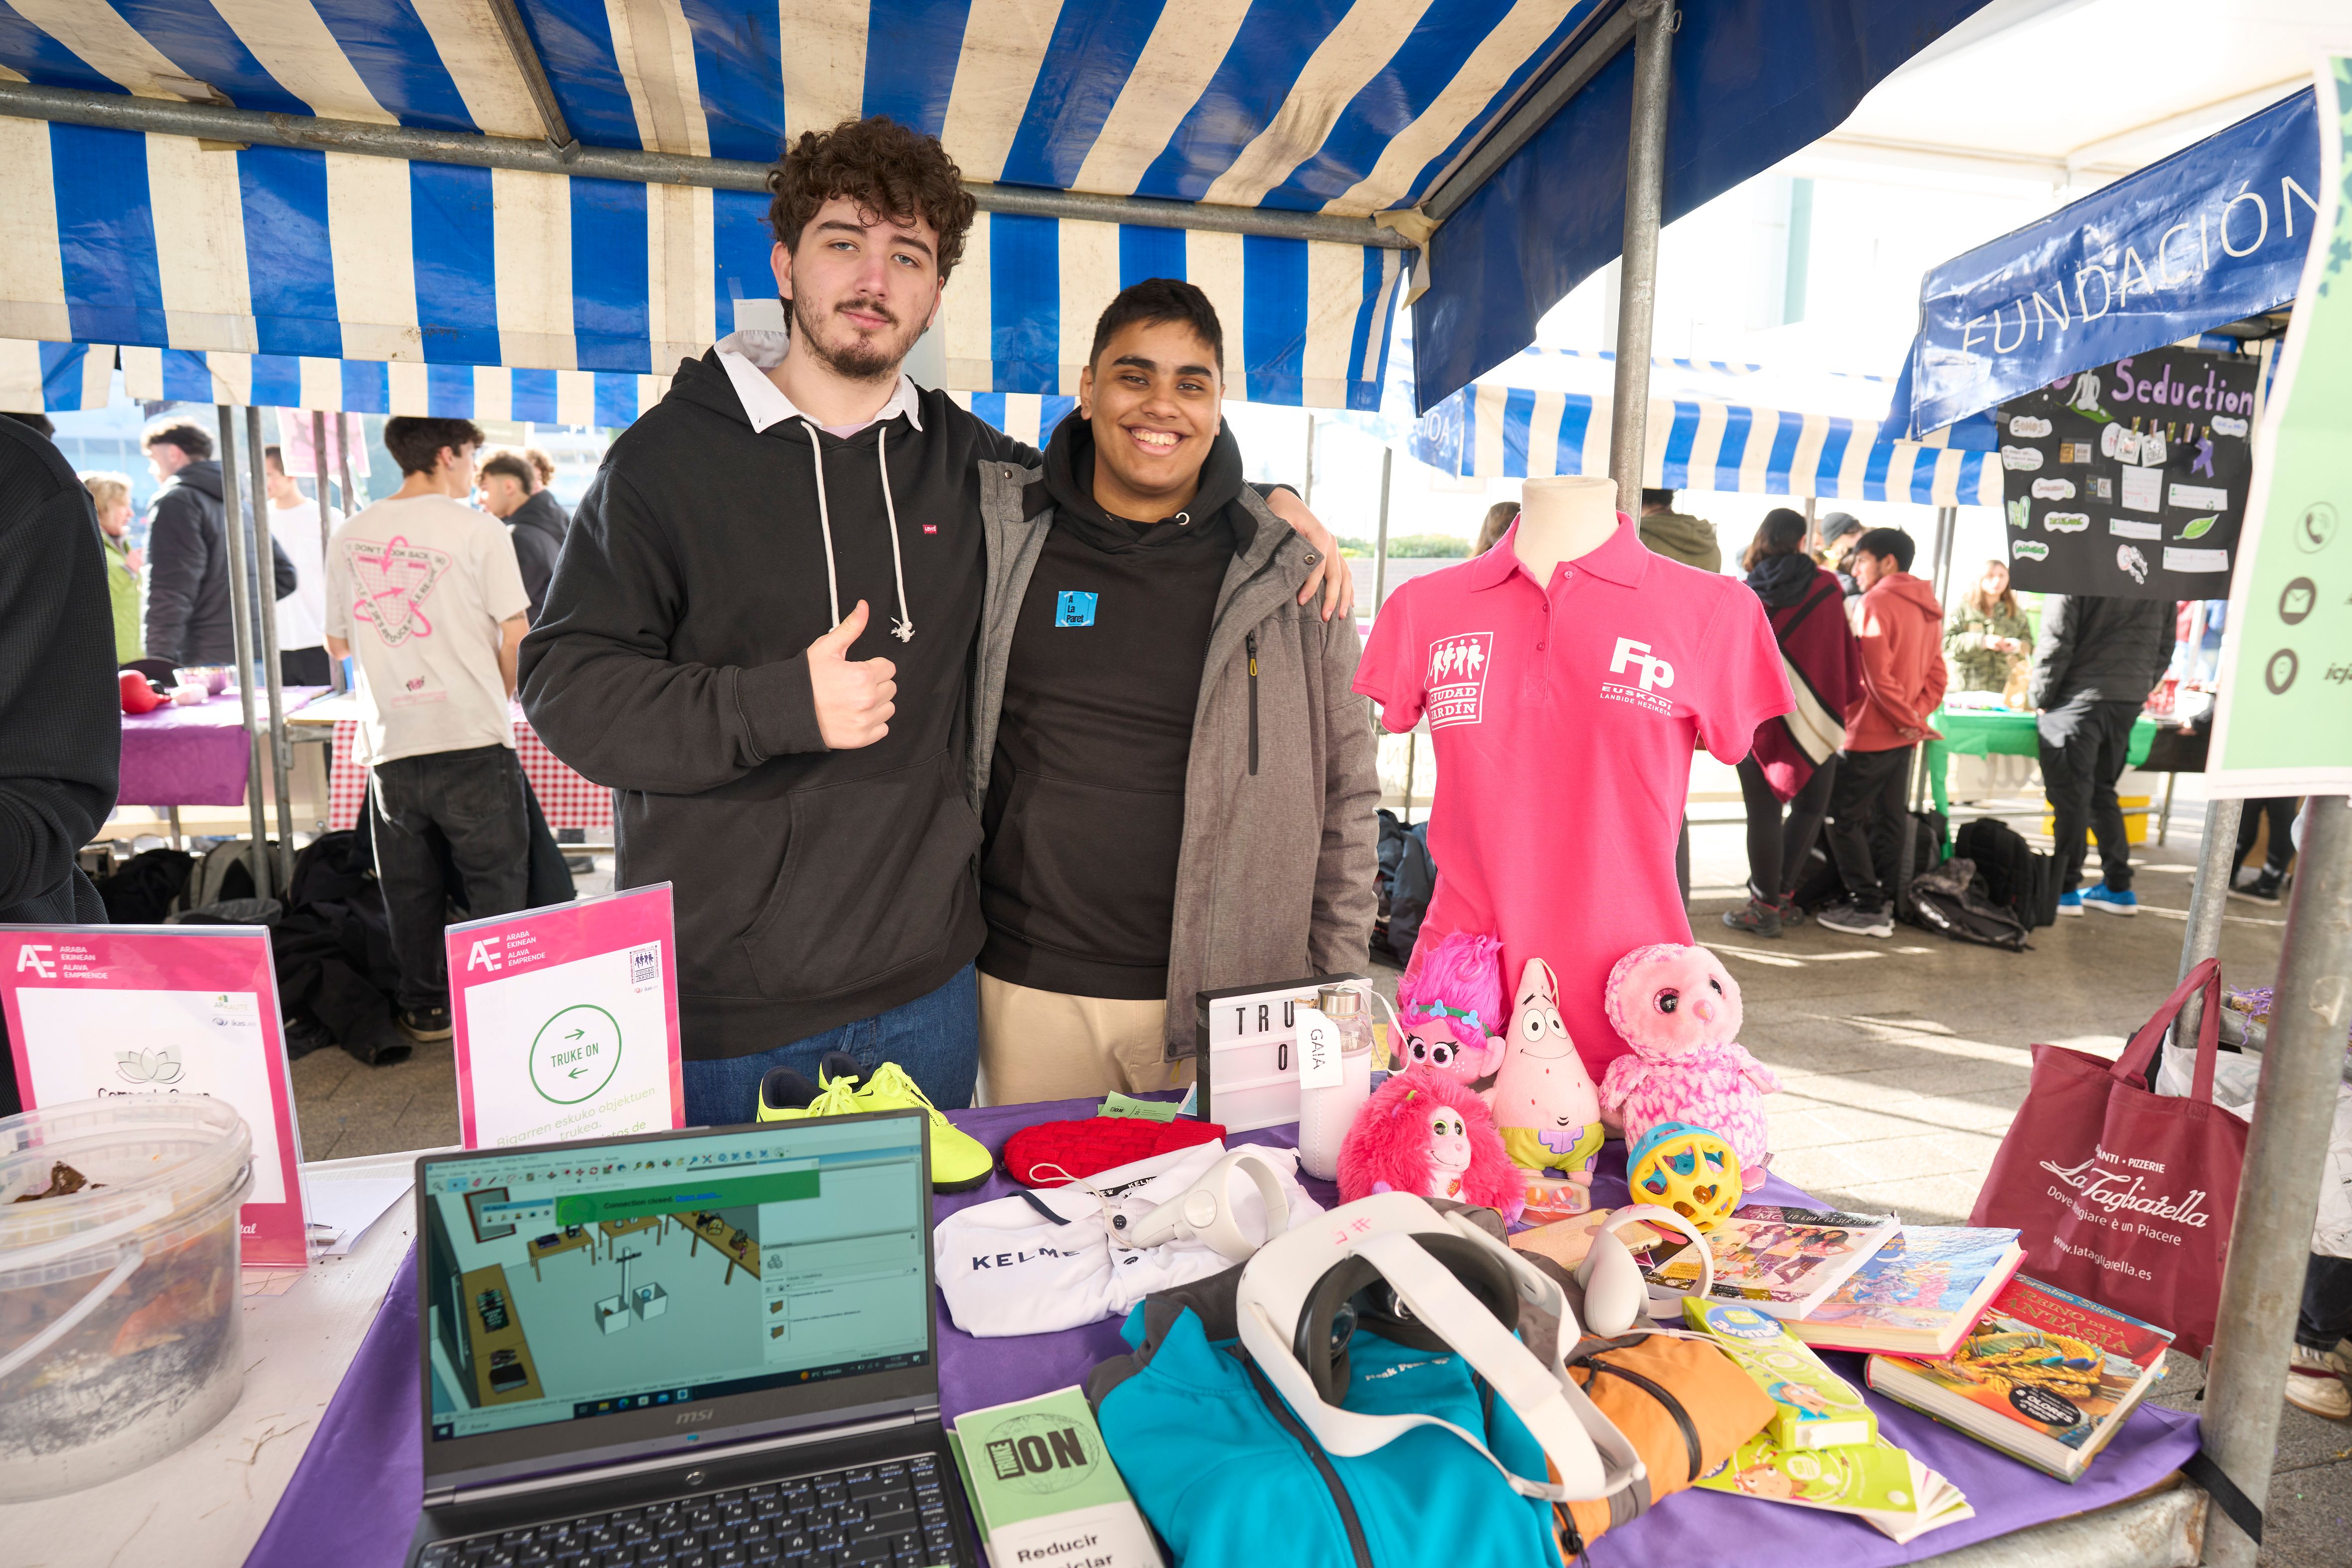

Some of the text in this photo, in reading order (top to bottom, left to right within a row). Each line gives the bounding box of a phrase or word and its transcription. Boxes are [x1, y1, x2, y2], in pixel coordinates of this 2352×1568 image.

[2112, 358, 2254, 417] Seduction
[1066, 614, 1084, 623] Paret
[1430, 687, 1477, 704] CIUDAD
[1600, 693, 1671, 717] LANBIDE HEZIKETA
[1602, 686, 1671, 710] EUSKADI
[1431, 702, 1476, 721] JARDÍN
[506, 931, 530, 941] ARABA
[507, 937, 536, 949] EKINEAN
[508, 949, 530, 959] ALAVA
[508, 952, 546, 967] EMPRENDE
[1236, 1001, 1295, 1035] TRU
[551, 1042, 599, 1068] TRUKE ON
[1310, 1028, 1326, 1070] GAIA
[497, 1087, 655, 1147] Bigarren eskuko objektuen
[632, 1121, 646, 1134] de
[2128, 1157, 2166, 1174] PIZZERIE
[1128, 1177, 1157, 1189] KELM
[603, 1199, 647, 1210] Connection
[2081, 1168, 2210, 1228] Tagliatella
[2047, 1185, 2074, 1208] Dove
[2121, 1222, 2133, 1232] un
[2137, 1224, 2181, 1246] Piacere
[972, 1247, 1080, 1270] KELME
[2014, 1274, 2125, 1322] Geronimo Stilton
[2016, 1288, 2125, 1338] REINO DE LA
[676, 1407, 715, 1425] msi
[2027, 1395, 2074, 1424] OLORES
[990, 1428, 1088, 1478] TRUKE ON
[1017, 1534, 1098, 1564] Reducir
